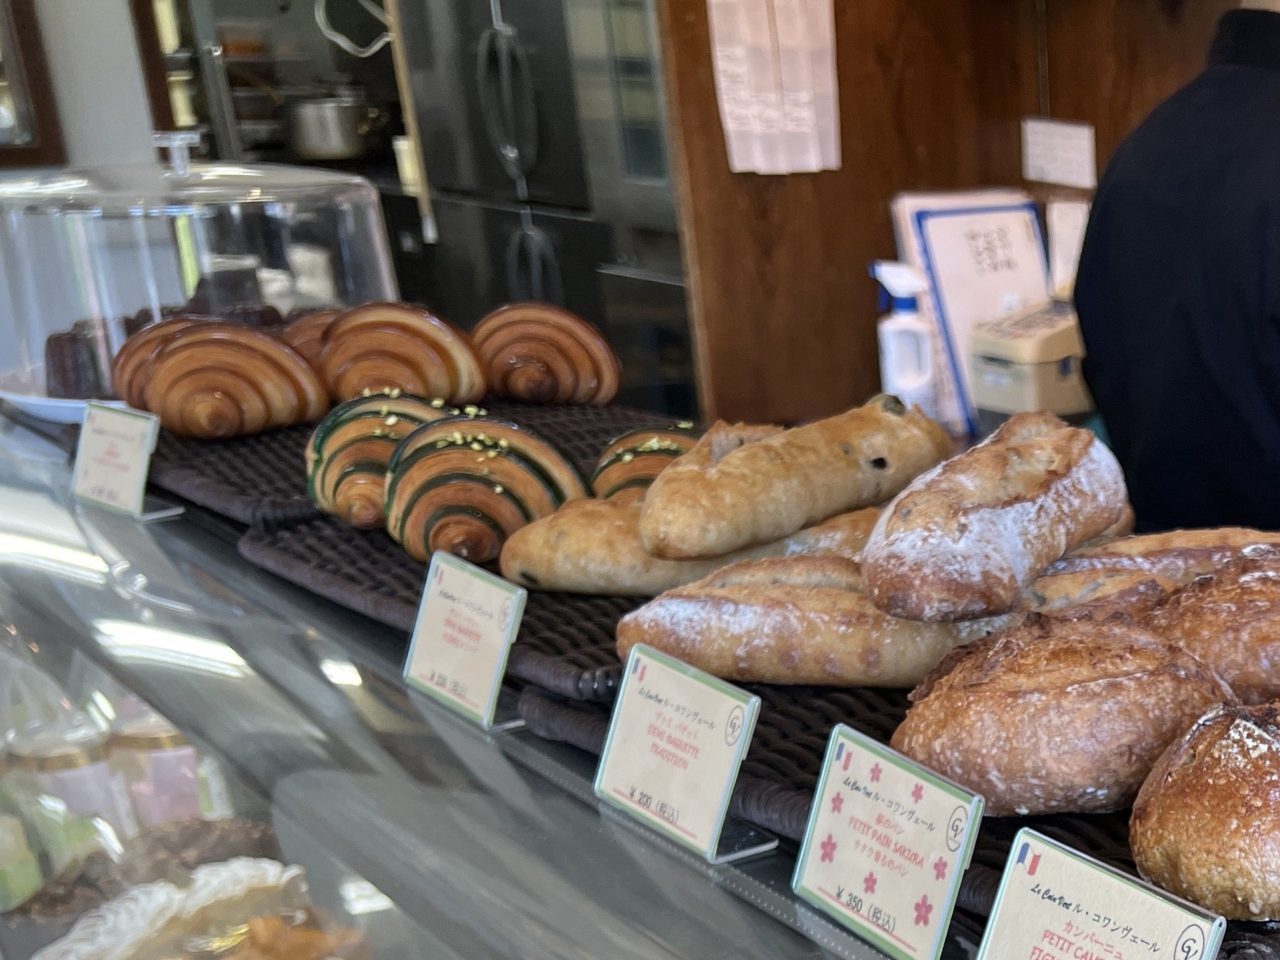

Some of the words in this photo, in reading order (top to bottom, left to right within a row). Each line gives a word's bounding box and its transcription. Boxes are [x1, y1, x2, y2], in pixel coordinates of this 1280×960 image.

[848, 815, 871, 836] PETIT
[870, 828, 893, 849] PAIN
[892, 841, 924, 868] SAKURA
[845, 892, 863, 914] 350
[1041, 929, 1075, 954] PETIT
[1062, 919, 1123, 960] カンパーニュ
